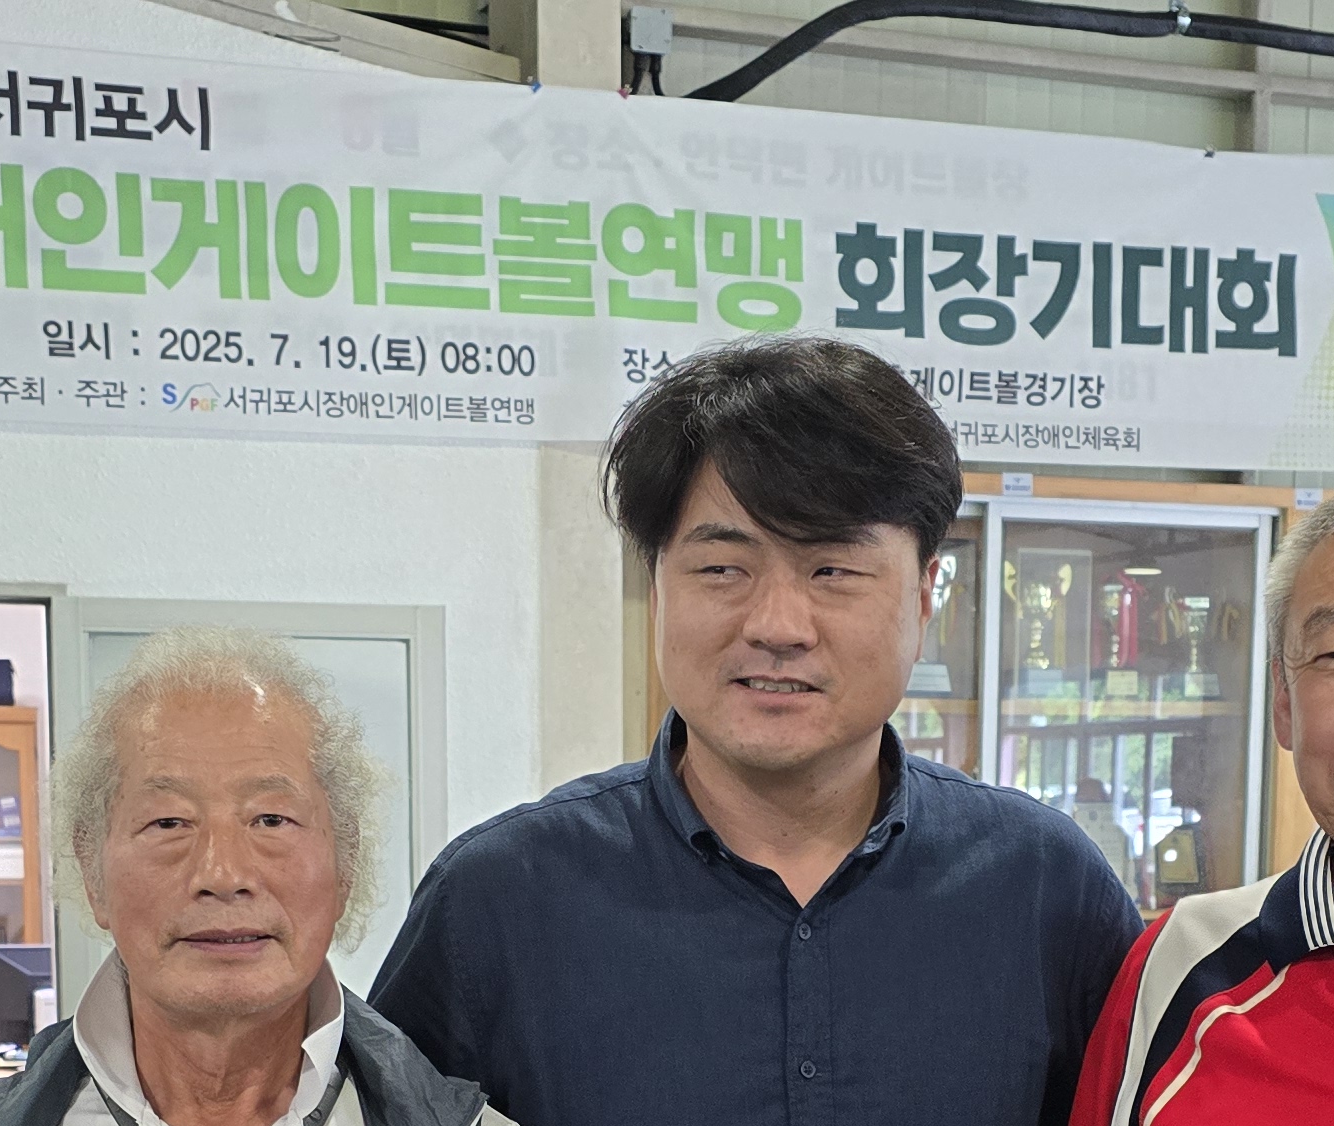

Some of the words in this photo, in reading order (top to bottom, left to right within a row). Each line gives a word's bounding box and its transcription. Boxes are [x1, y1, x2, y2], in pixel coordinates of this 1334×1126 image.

[835, 222, 1298, 358] 회장기대회
[41, 319, 112, 361] 일시
[158, 327, 255, 368] 2025.
[269, 331, 302, 369] 7.
[440, 341, 536, 377] 08:00
[74, 378, 128, 410] 주관
[224, 386, 536, 426] 서귀포시장애인게이트볼연맹
